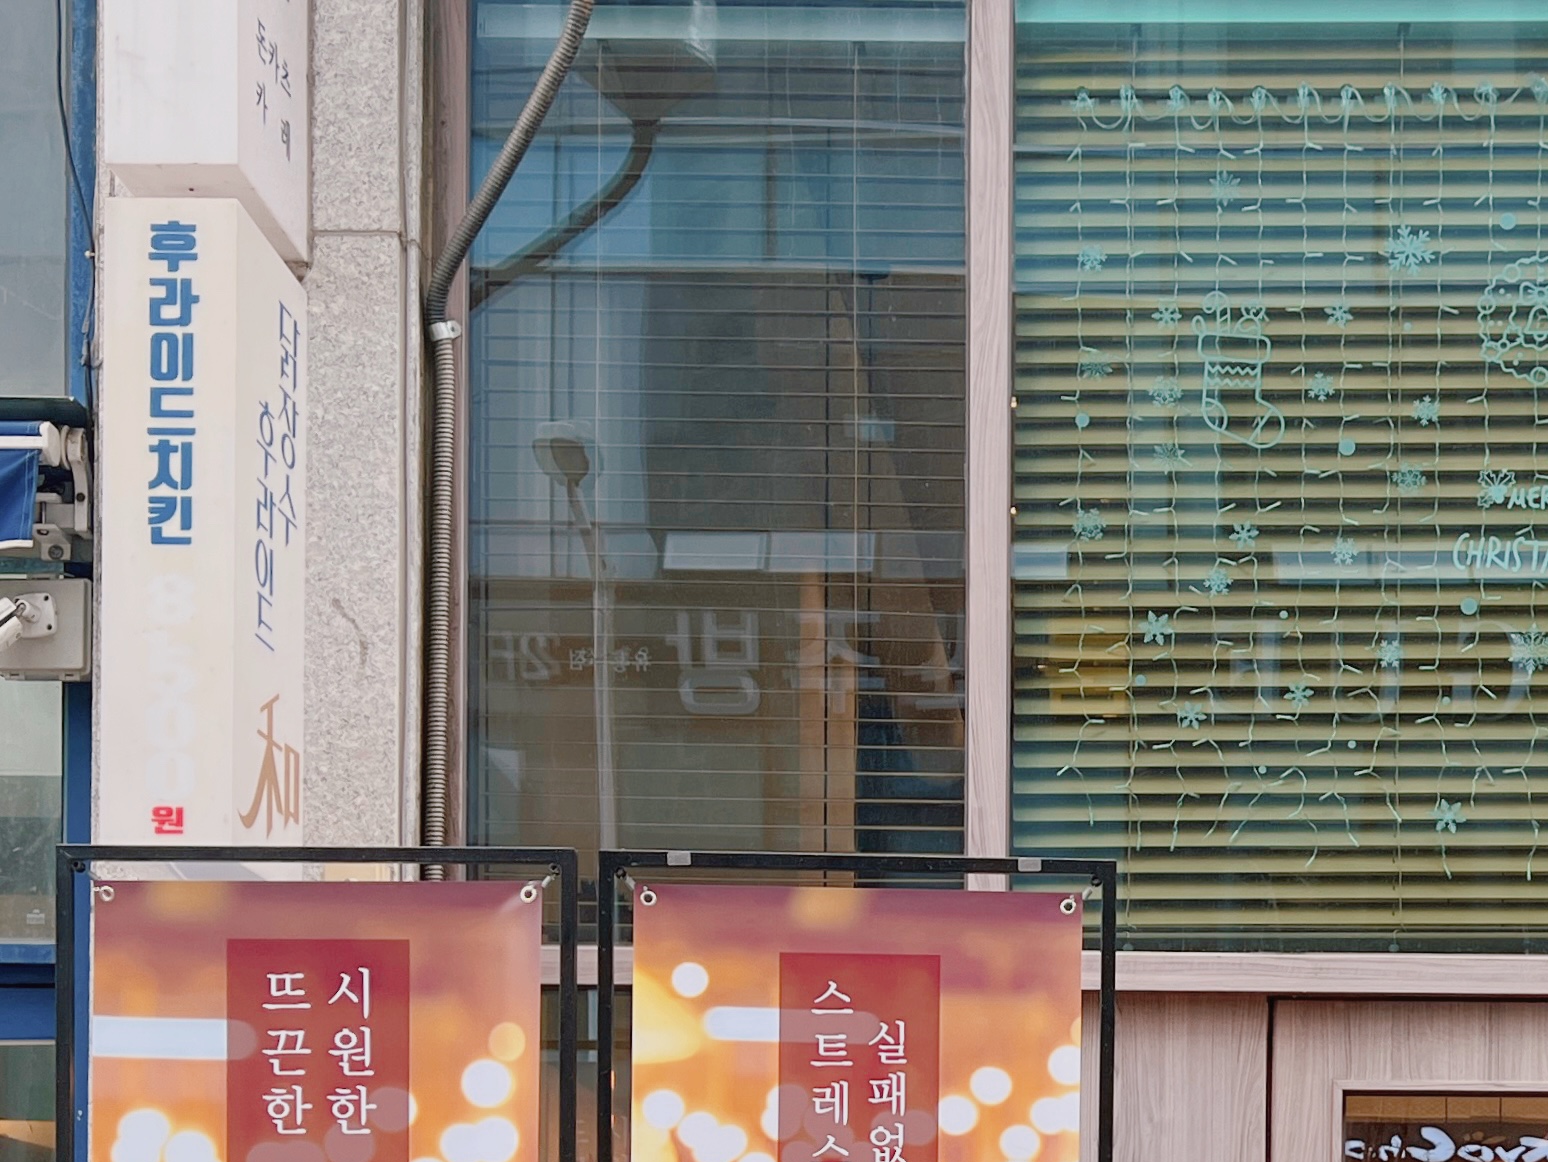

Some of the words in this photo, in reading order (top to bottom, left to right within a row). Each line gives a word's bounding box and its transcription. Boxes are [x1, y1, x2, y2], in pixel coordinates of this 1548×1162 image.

[256, 18, 292, 98] 돈카츠
[147, 219, 199, 546] 후라이드치킨
[278, 300, 299, 547] 닭장수
[254, 399, 277, 653] 후라이드
[151, 805, 186, 836] 원
[239, 693, 300, 840] 和
[262, 971, 312, 1135] 뜨끈한
[326, 966, 376, 1137] 시원한
